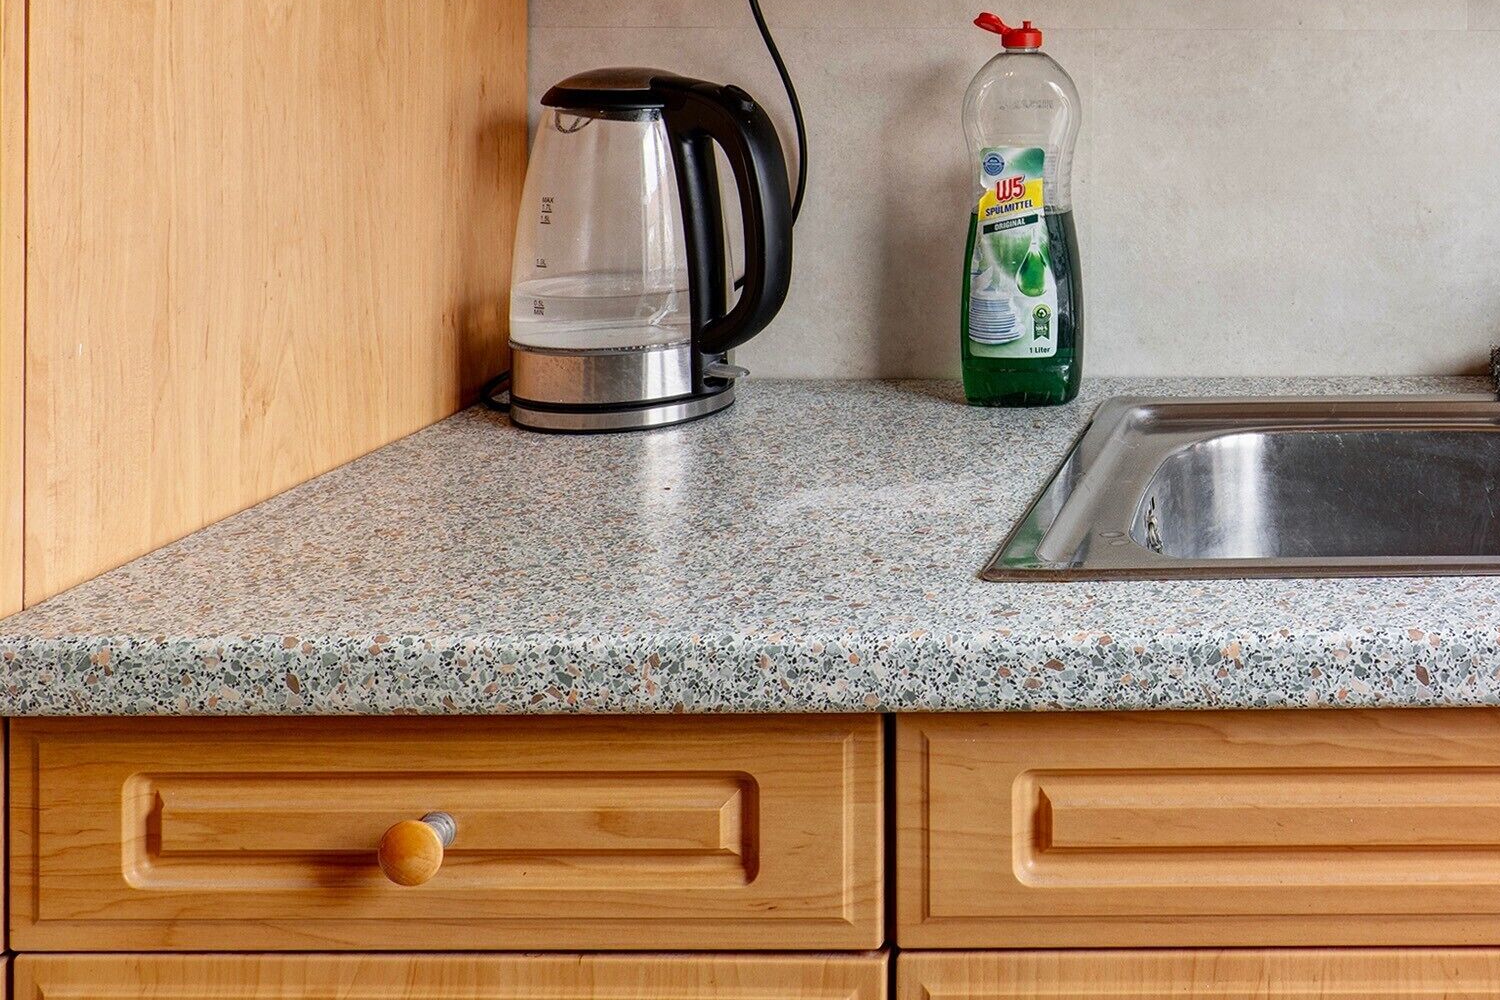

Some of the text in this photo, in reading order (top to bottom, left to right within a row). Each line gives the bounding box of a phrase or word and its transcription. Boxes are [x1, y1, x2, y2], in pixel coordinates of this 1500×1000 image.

[995, 175, 1025, 203] W5
[985, 199, 1033, 217] SPÜLMITTEL
[994, 218, 1026, 231] ORIGINAL
